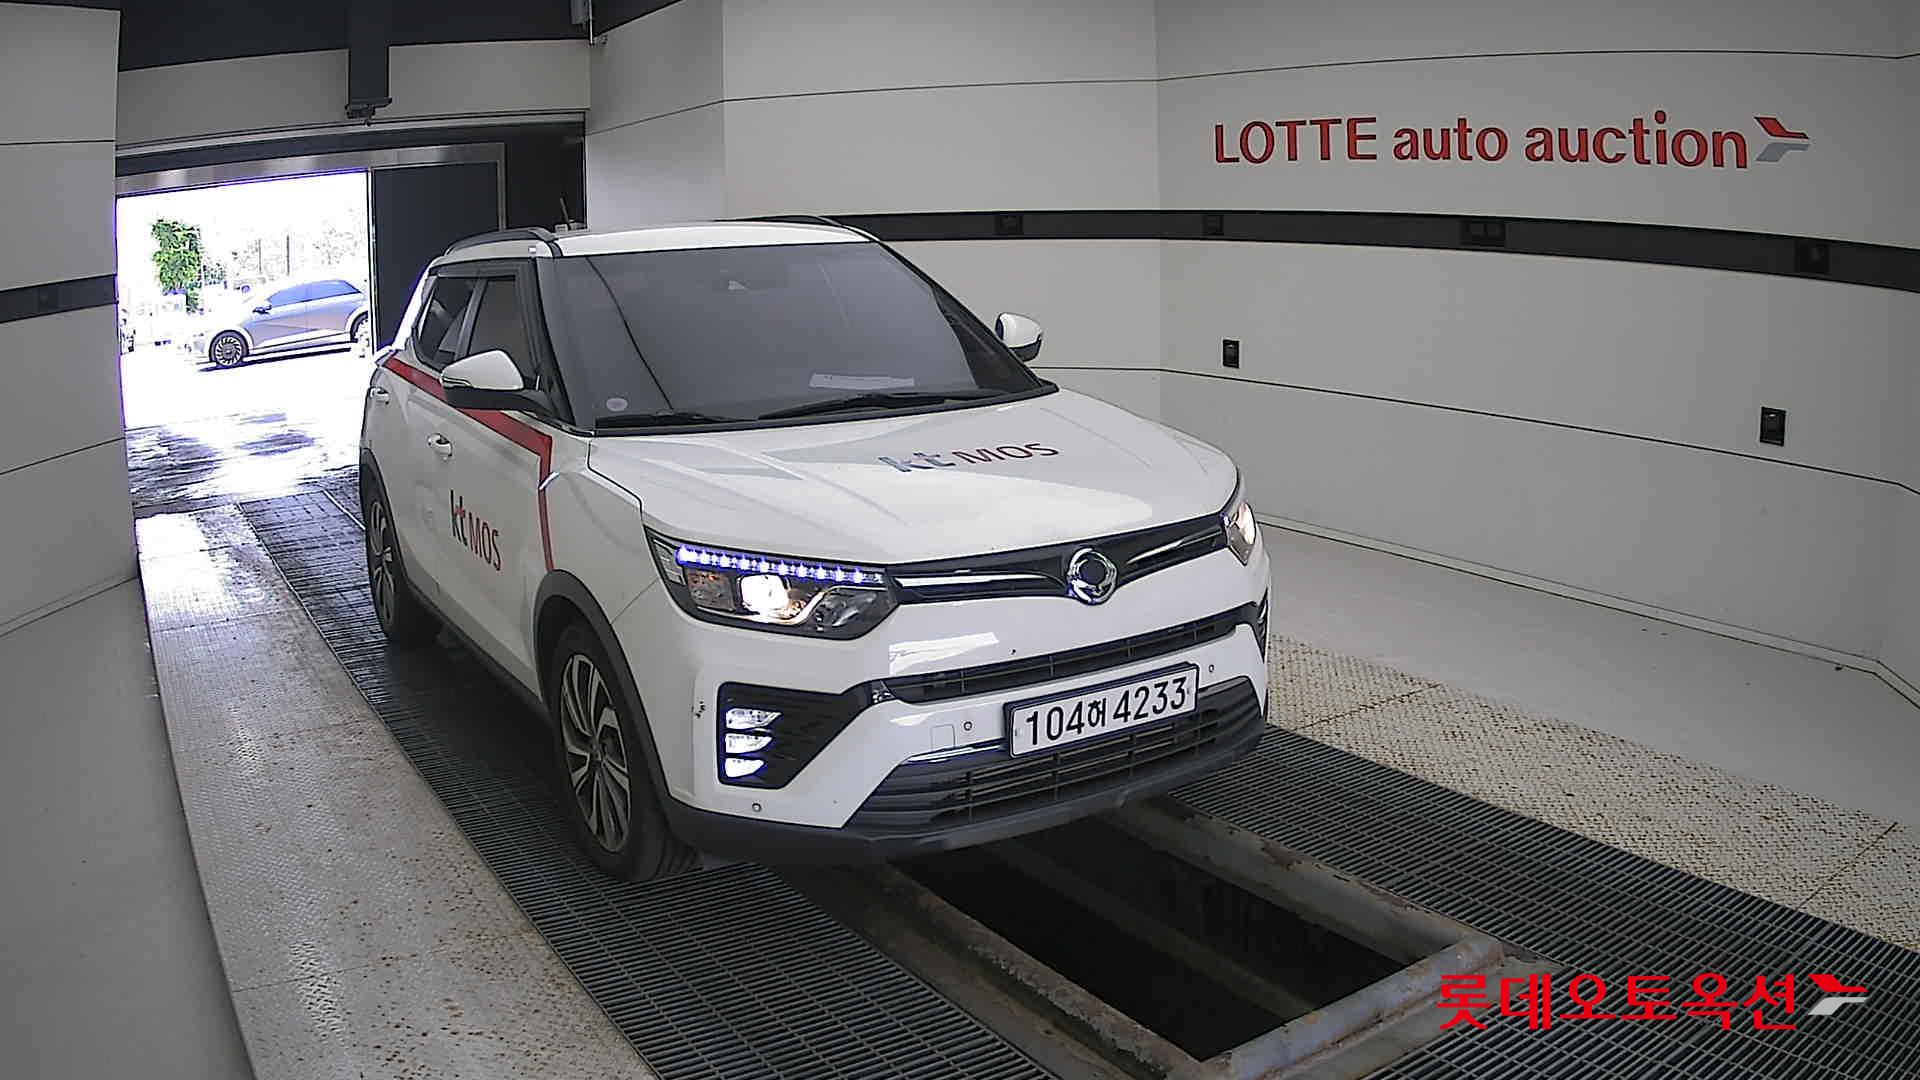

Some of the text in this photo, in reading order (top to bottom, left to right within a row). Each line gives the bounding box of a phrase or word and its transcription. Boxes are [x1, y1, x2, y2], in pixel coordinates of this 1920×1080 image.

[1214, 110, 1749, 169] LOTTE auto auction
[878, 443, 1059, 472] kt MOS
[450, 489, 501, 571] kt MOS
[1026, 677, 1187, 745] 104허 4233
